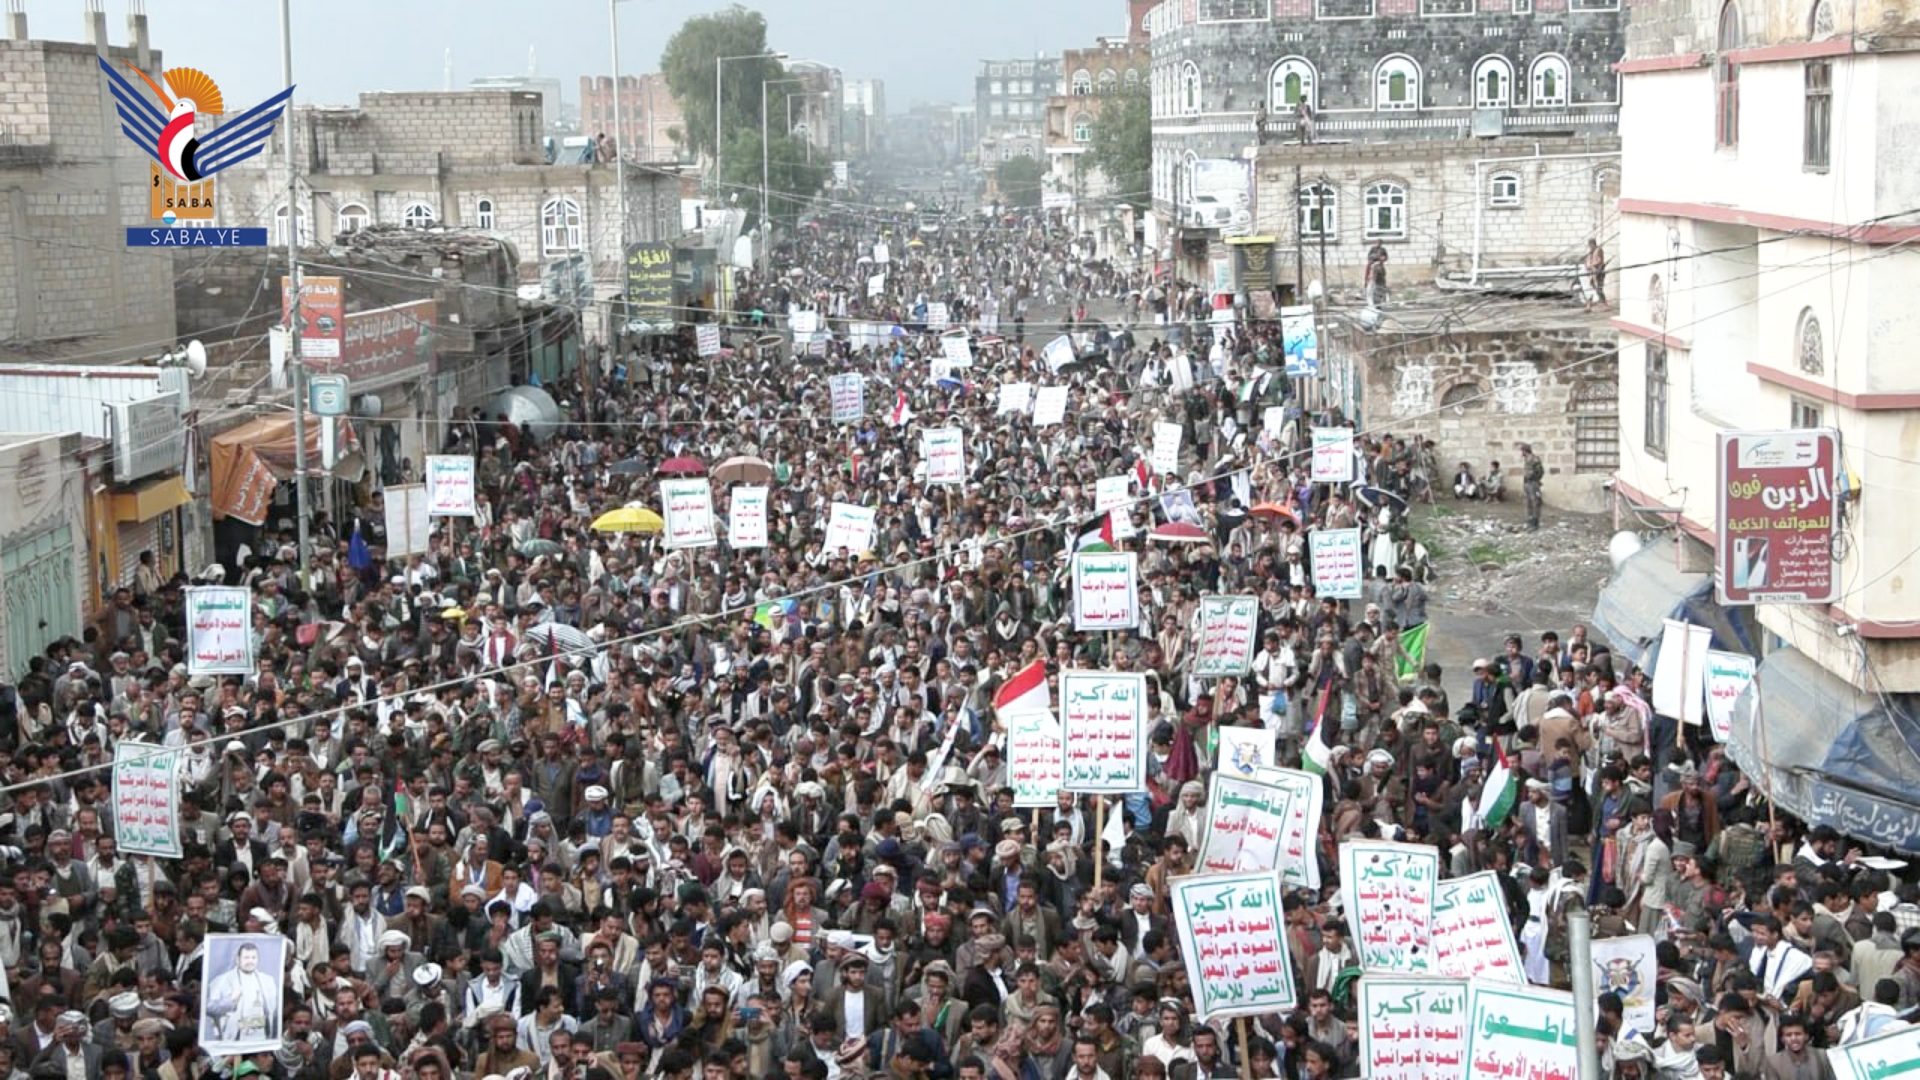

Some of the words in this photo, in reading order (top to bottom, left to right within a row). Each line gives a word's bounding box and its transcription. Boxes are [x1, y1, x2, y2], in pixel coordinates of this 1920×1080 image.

[1762, 467, 1830, 512] الزين
[1728, 516, 1769, 533] الذكية
[1773, 516, 1829, 532] للهواتف
[1111, 685, 1136, 701] الله
[1241, 888, 1271, 908] الله
[1238, 916, 1274, 935] الموت
[1241, 939, 1279, 957] الموت
[1249, 977, 1286, 1002] النصر
[1428, 992, 1463, 1014] الله
[1424, 1022, 1463, 1042] الموت
[1425, 1050, 1464, 1066] الموت
